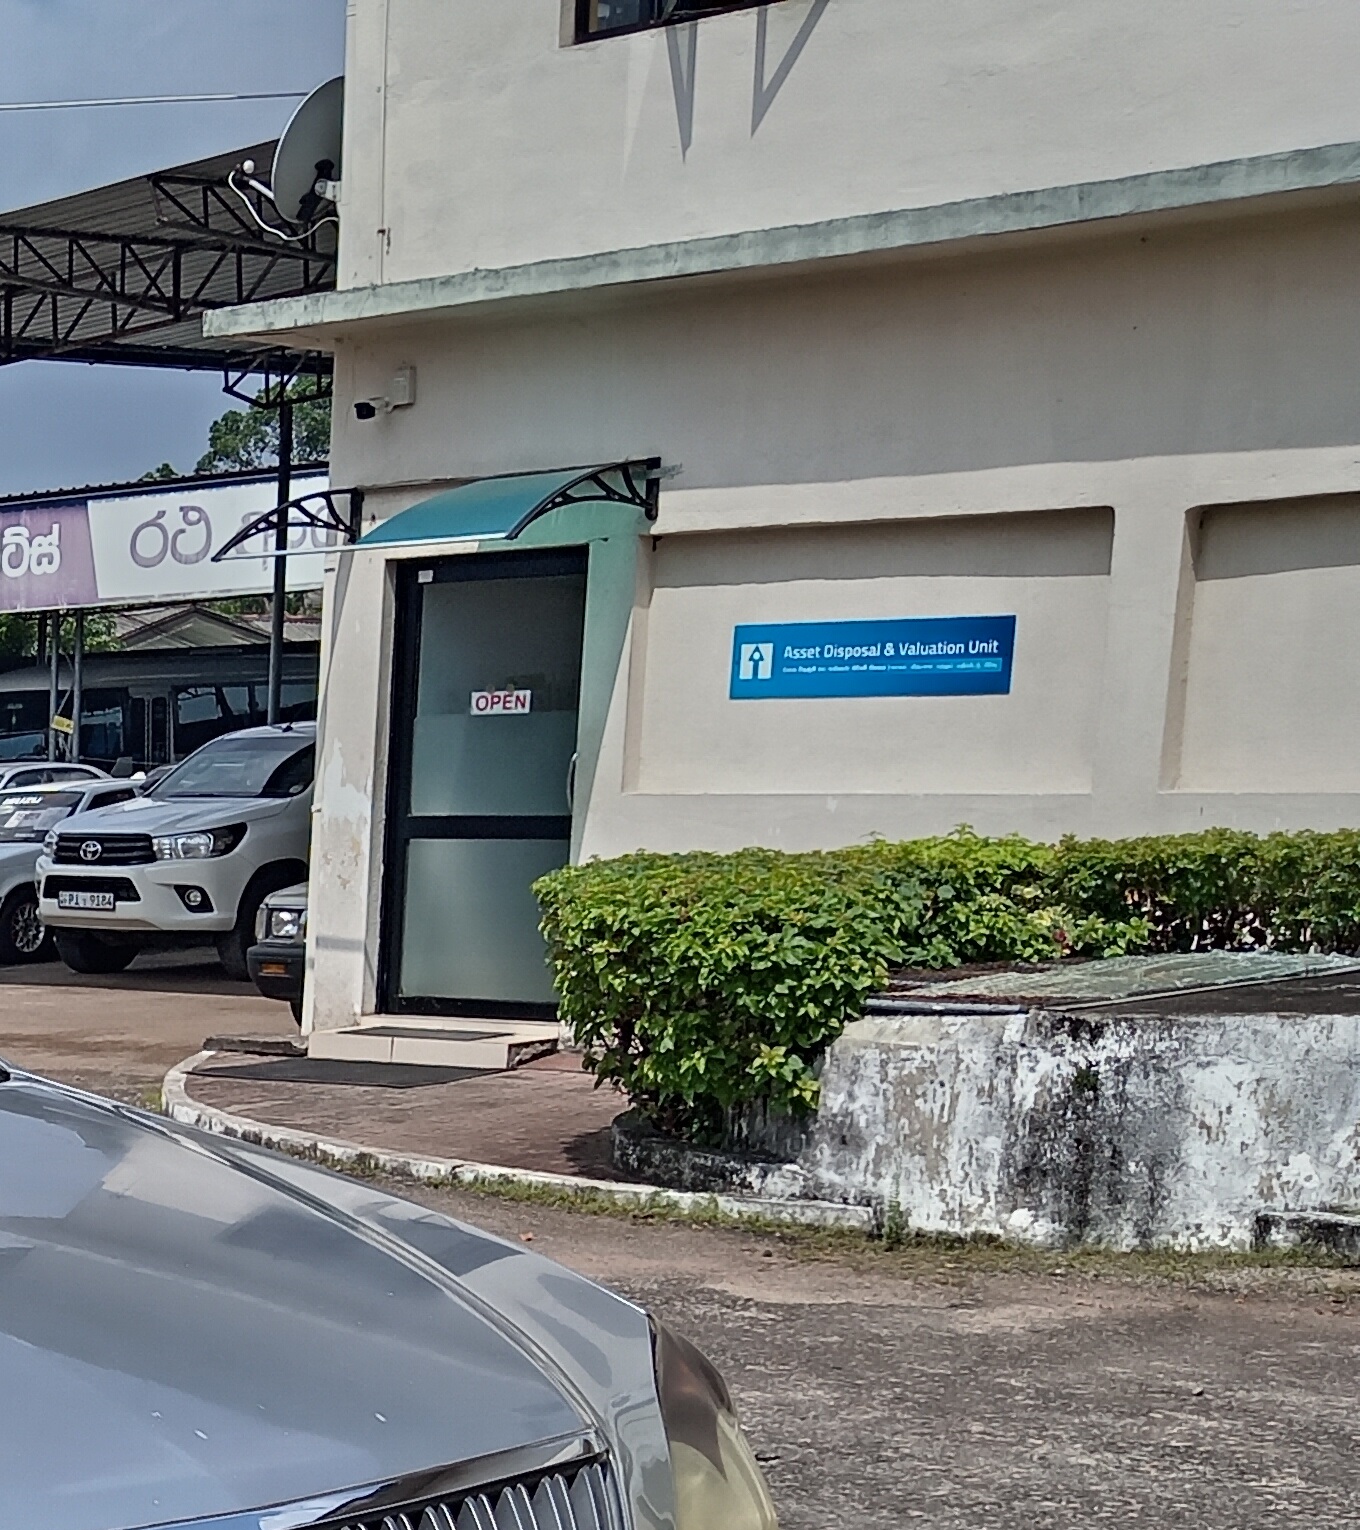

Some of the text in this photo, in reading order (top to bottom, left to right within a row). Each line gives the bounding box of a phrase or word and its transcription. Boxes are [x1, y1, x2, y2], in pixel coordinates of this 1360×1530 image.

[783, 639, 999, 660] Asset Disposal & Valuation Unit
[475, 693, 527, 711] OPEN
